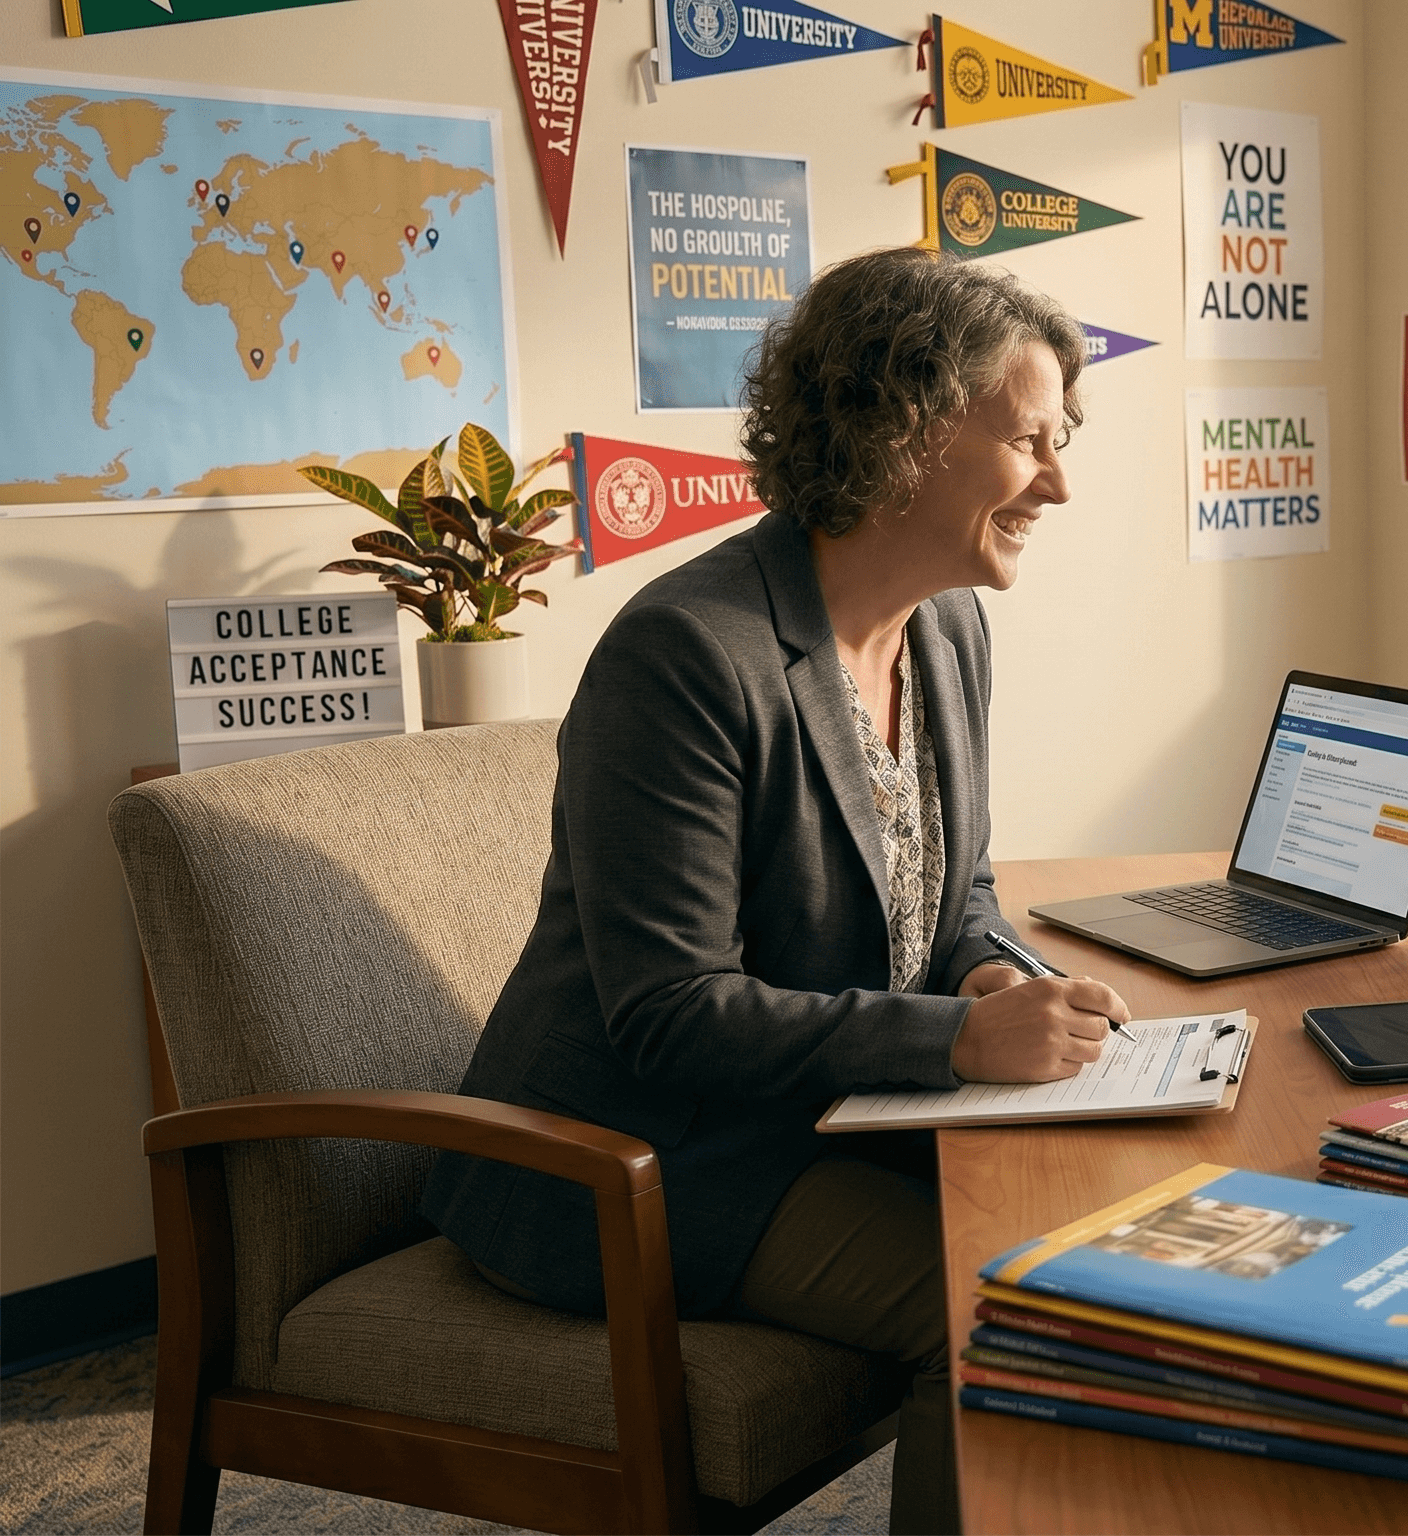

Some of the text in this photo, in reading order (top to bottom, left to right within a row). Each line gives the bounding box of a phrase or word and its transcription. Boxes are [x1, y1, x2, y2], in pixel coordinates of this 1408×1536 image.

[742, 6, 857, 49] UNIVERSITY
[1218, 25, 1296, 50] UNIVERSITY
[996, 58, 1088, 100] UNIVERSITY
[1219, 141, 1285, 185] YOU
[648, 191, 791, 228] THE HOSPOLNE,
[1000, 190, 1078, 215] COLLEGE
[1221, 189, 1286, 230] ARE
[1002, 212, 1078, 232] UNIVERSITY
[650, 227, 677, 253] NO
[767, 233, 790, 258] OF
[1222, 234, 1288, 276] NOT
[652, 262, 792, 301] POTENTIAL
[1201, 281, 1308, 322] ALONE
[1202, 417, 1314, 450] MENTAL
[1204, 455, 1313, 491] HEALTH
[1199, 494, 1320, 531] MATTERS
[216, 606, 352, 639] COLLEGE
[190, 648, 386, 685] ACCEPTANCE
[218, 691, 370, 728] SUCCESS!
